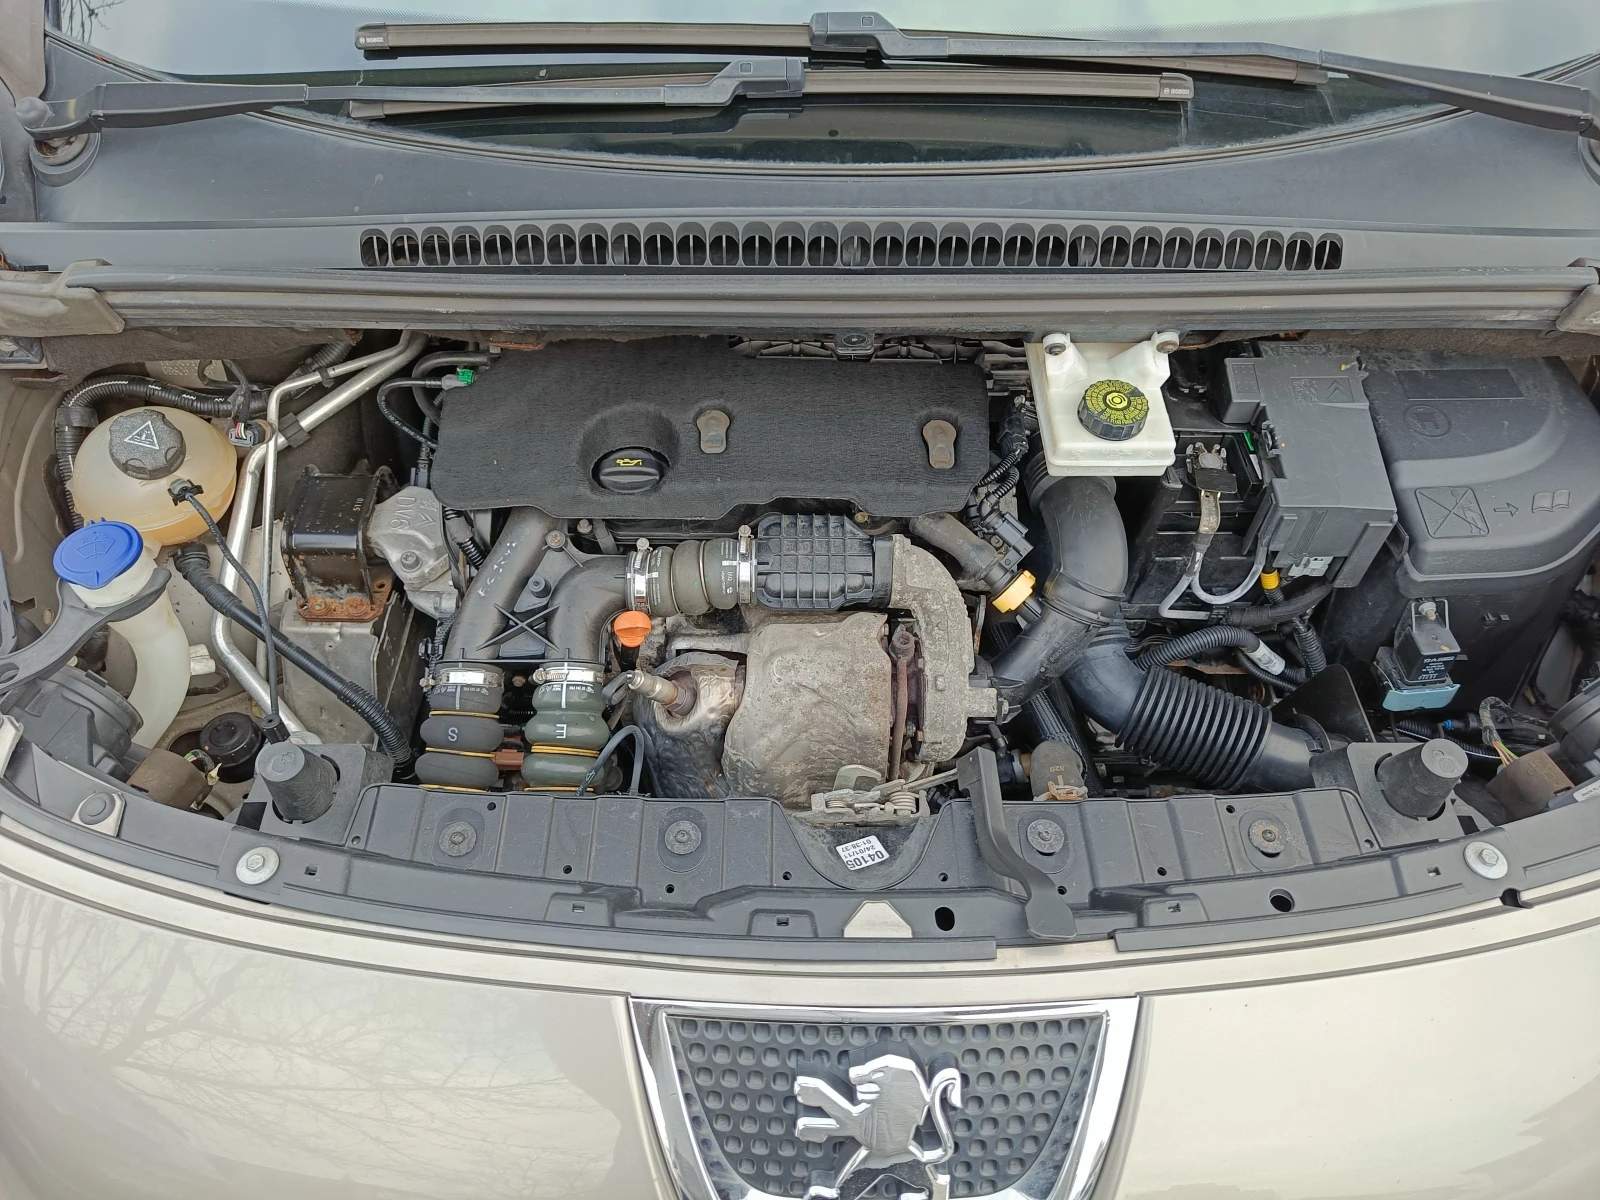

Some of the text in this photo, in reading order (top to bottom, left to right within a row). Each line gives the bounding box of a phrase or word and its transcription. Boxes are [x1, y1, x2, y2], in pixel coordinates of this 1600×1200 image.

[389, 496, 417, 531] DV6
[447, 726, 458, 742] S
[555, 723, 567, 739] E
[840, 838, 872, 853] 01:38:37
[843, 844, 876, 859] 24/01/11
[846, 849, 885, 869] 04105
